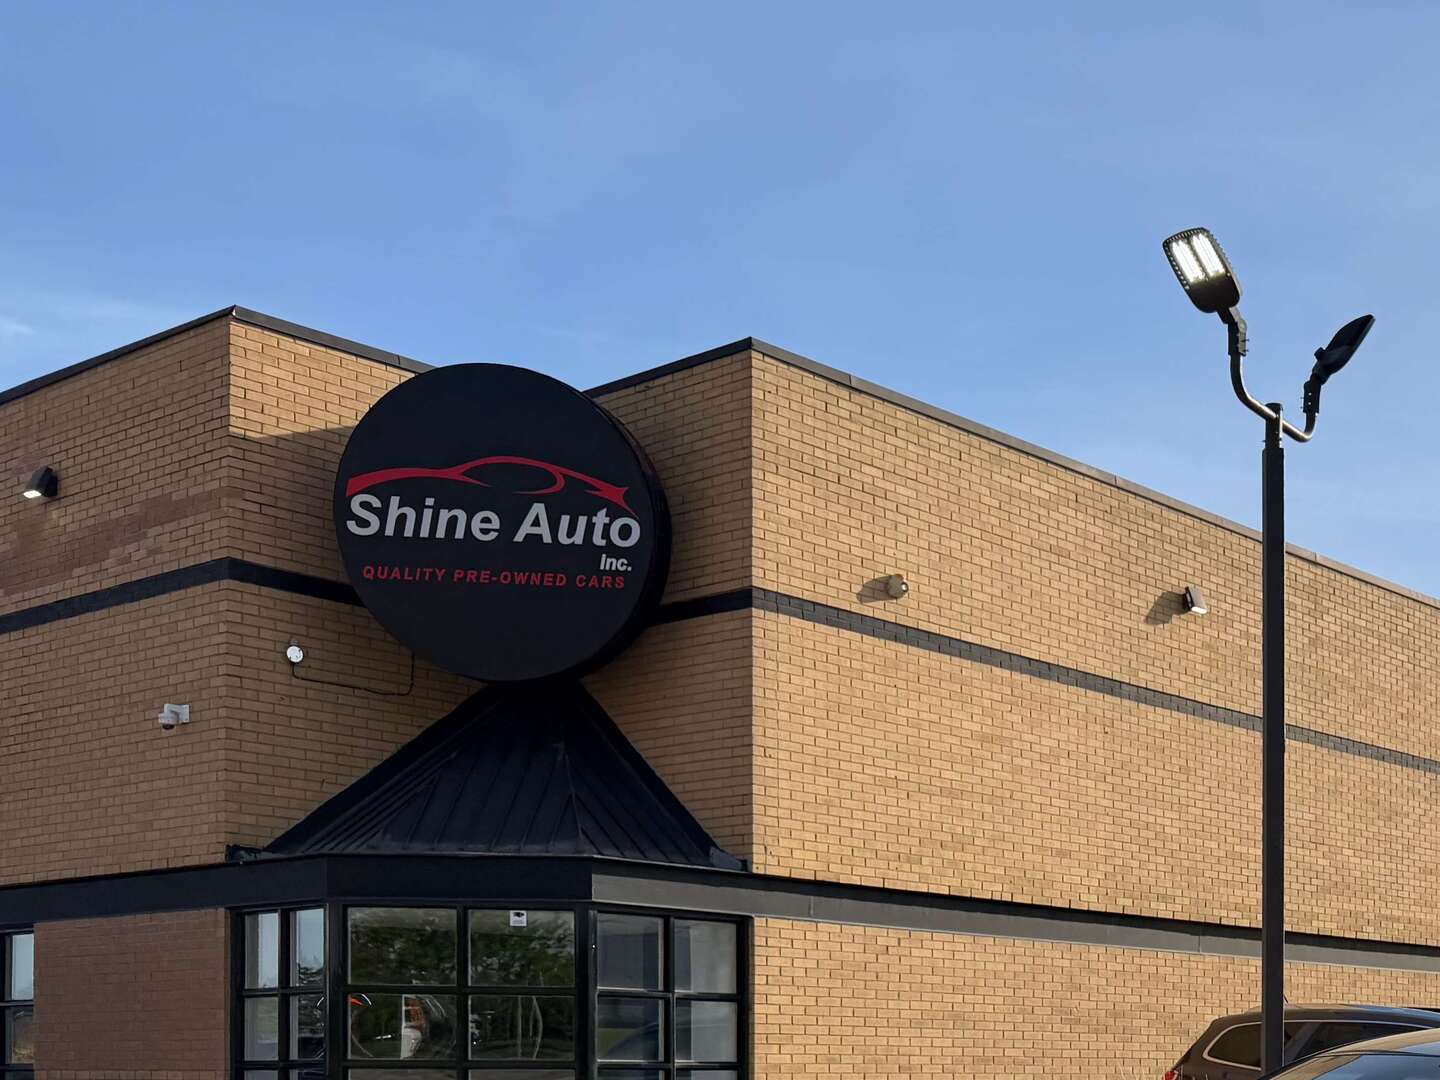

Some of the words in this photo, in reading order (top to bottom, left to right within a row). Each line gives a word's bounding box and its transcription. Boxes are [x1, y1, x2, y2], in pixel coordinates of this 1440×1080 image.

[346, 493, 501, 541] Shine
[513, 502, 641, 548] Auto
[362, 566, 446, 582] QUALITY
[453, 568, 567, 587] PRE-OWNED
[575, 574, 625, 589] CARS
